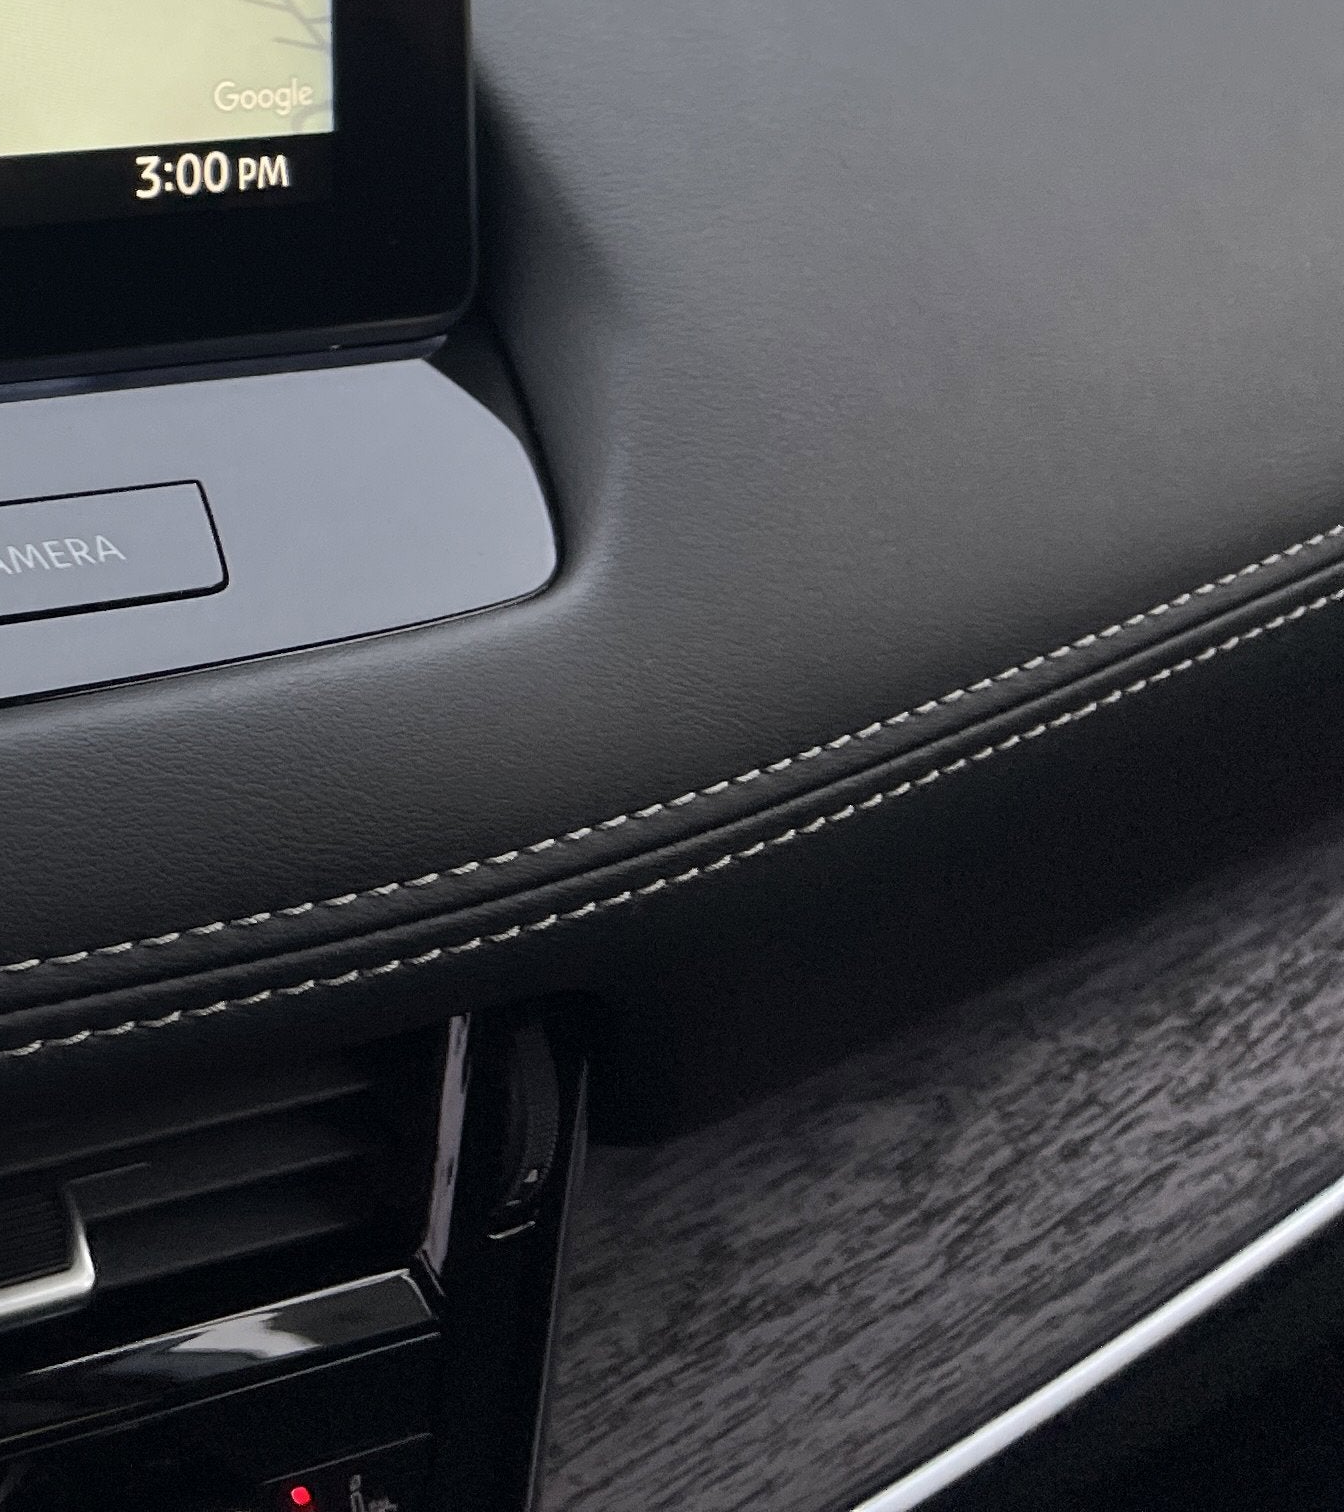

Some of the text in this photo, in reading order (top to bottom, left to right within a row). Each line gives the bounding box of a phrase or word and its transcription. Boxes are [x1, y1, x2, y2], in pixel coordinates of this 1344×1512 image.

[214, 78, 313, 117] Google
[134, 151, 290, 200] 3:00 PM
